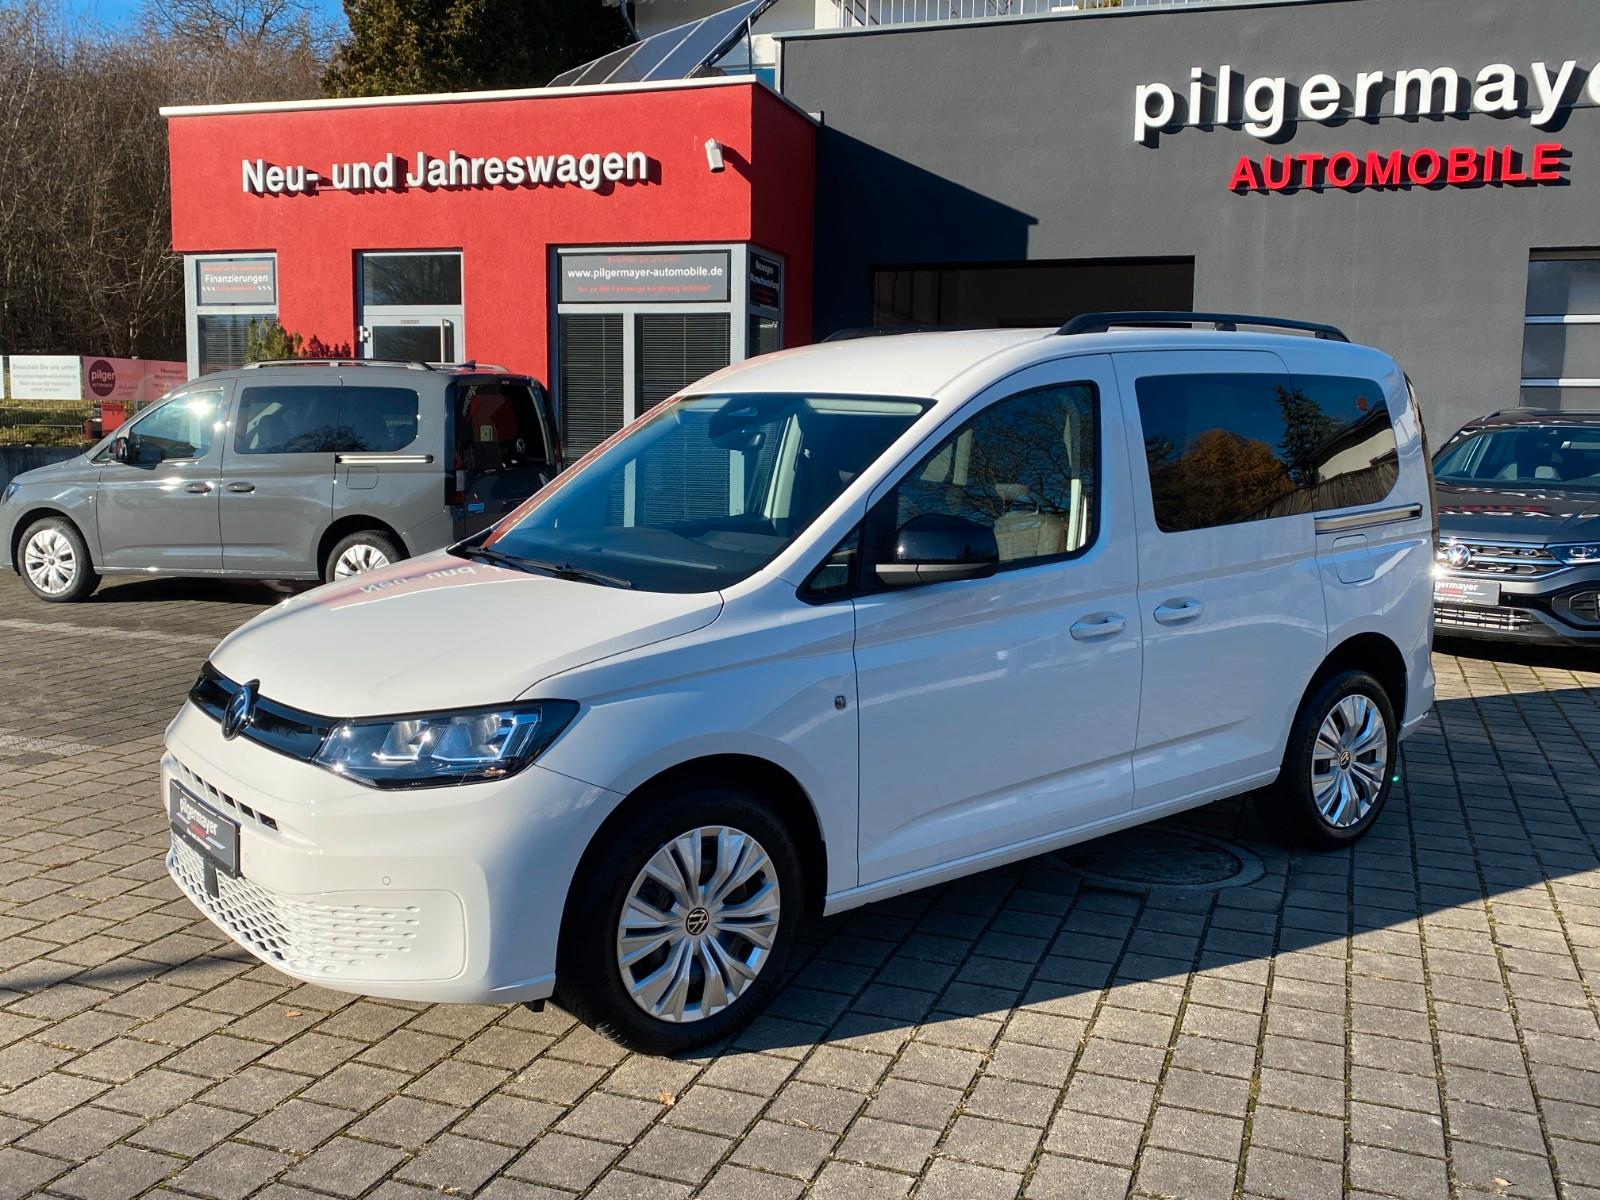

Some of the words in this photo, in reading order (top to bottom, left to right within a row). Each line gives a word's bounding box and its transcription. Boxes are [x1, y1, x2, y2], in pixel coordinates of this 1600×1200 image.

[241, 158, 319, 193] Neu-
[331, 152, 395, 190] und
[405, 150, 648, 190] Jahreswagen
[1228, 143, 1563, 191] AUTOMOBILE
[204, 273, 269, 285] Finanzierungen
[567, 266, 723, 280] www.pilgermayer-automobile.de
[91, 369, 116, 382] pilger
